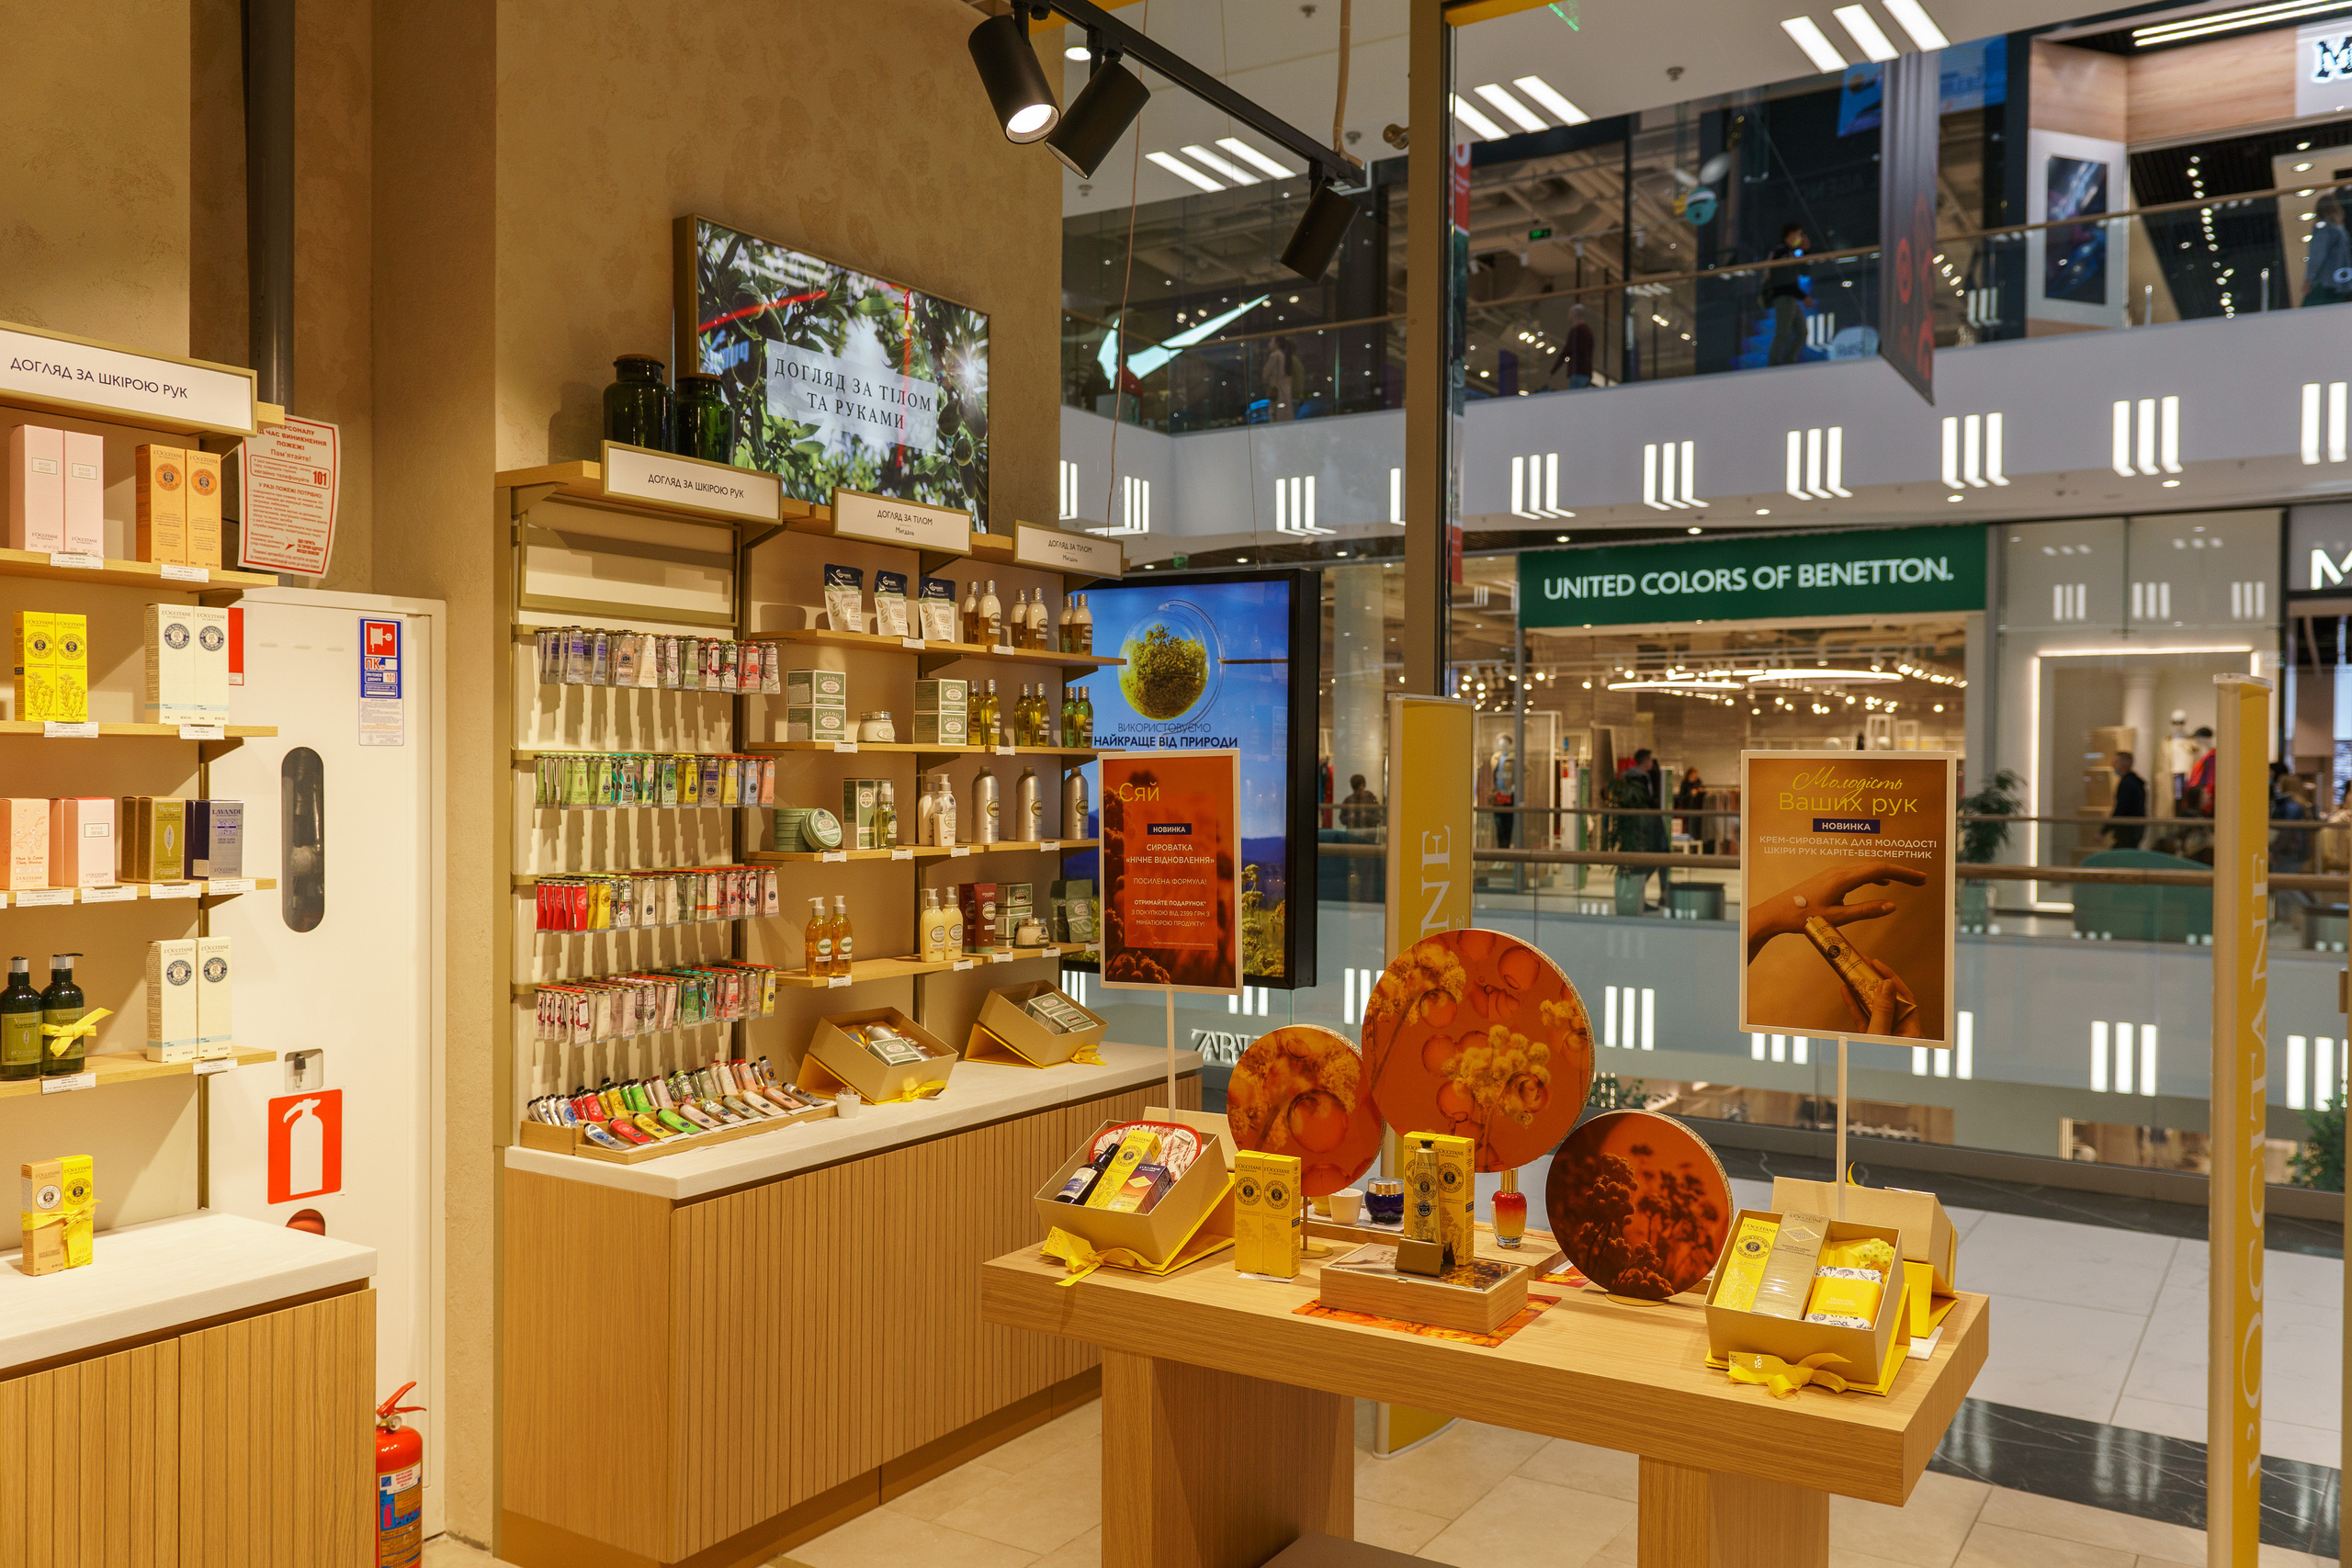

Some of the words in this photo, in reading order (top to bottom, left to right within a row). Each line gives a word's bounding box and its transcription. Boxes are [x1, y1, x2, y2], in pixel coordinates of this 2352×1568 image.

[10, 357, 73, 380] ДОГЛЯД
[76, 368, 95, 382] ЗА
[98, 372, 159, 393] ШКІРОЮ
[163, 384, 188, 399] РУК
[775, 358, 846, 394] ДОГЛЯД
[853, 378, 873, 398] ЗА
[878, 384, 932, 412] ТІЛОМ
[807, 391, 828, 412] ТА
[835, 400, 904, 430] РУКАМИ
[276, 440, 305, 451] ПОЖЕЖІ
[281, 433, 327, 446] ВИНИКНЕННЯ
[312, 470, 327, 486] 101
[648, 474, 682, 489] ДОГЛЯД
[684, 480, 693, 490] ЗА
[695, 482, 728, 495] ШКІРОЮ
[730, 488, 744, 498] РУК
[877, 510, 903, 522] ДОГЛЯД
[904, 513, 911, 523] ЗА
[912, 515, 933, 525] ТІЛОМ
[895, 527, 915, 536] Мигдаль
[1048, 540, 1069, 551] ДОГЛЯД
[1076, 544, 1092, 553] ТІЛОМ
[1544, 573, 1635, 600] UNITED
[1640, 567, 1747, 596] COLORS
[1752, 565, 1792, 591] OF
[1798, 557, 1955, 589] BENETTON.
[366, 658, 380, 670] ПК
[1117, 723, 1212, 733] ВИКОРИСТОВУЄМО
[1094, 734, 1156, 749] НАЙКРАЩЕ
[1159, 737, 1177, 749] ВІД
[1181, 737, 1238, 749] ПРИРОДИ
[1119, 782, 1159, 802] Сяй
[1792, 766, 1903, 803] Молодість
[1779, 792, 1863, 812] Ваших
[1872, 797, 1917, 816] рук
[1822, 822, 1871, 830] НОВИНКА
[1759, 836, 1848, 846] КРЕМ-СИРОВАТКА
[1850, 839, 1871, 848] ДЛЯ
[1875, 840, 1937, 849] МОЛОДОСТІ
[1154, 856, 1215, 864] ВІДНОВЛЕННЯ»
[1764, 847, 1796, 855] ШКІРИ
[1820, 849, 1932, 859] КАРІТЕ-БЕЗСМЕРТНИК
